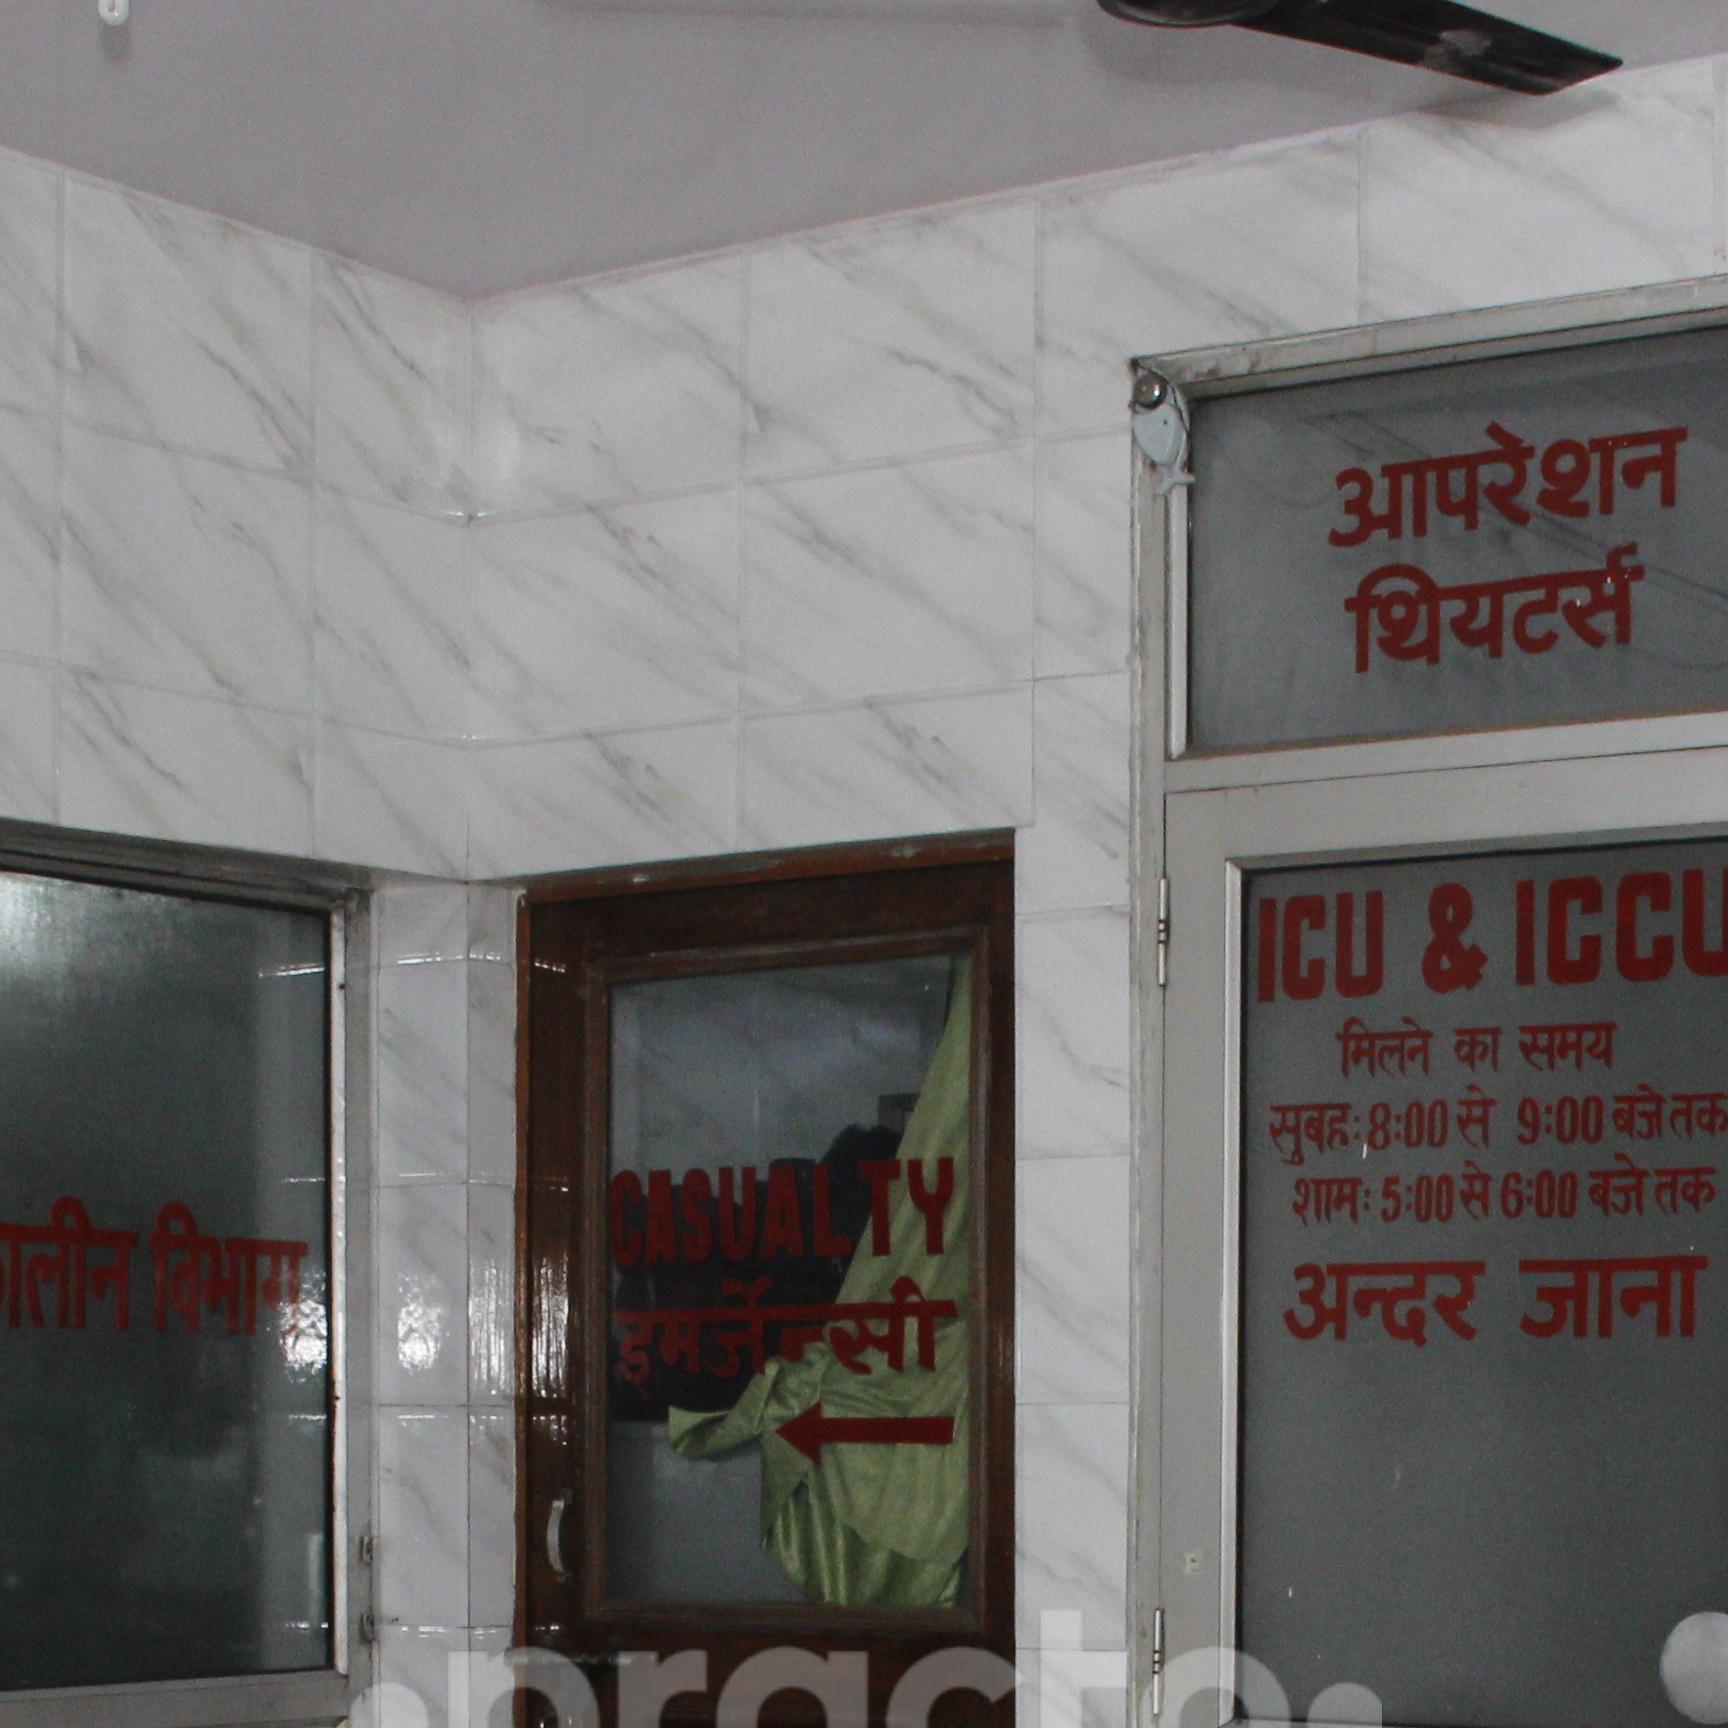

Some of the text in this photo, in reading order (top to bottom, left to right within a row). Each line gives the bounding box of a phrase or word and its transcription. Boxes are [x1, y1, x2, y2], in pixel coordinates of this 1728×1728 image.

[1327, 420, 1689, 548] आपरेशन
[1257, 890, 1384, 1002] ICU
[1421, 882, 1488, 996] &
[1336, 1017, 1617, 1078] मिलने का समय
[1368, 1099, 1449, 1150] 8:00
[1457, 1084, 1497, 1149] से
[1518, 1095, 1604, 1145] 9:00
[1613, 1083, 1665, 1140] बजे
[610, 1157, 954, 1268] CASUALTY
[1381, 1174, 1454, 1223] 5:00
[1460, 1159, 1493, 1221] से
[1501, 1170, 1579, 1219] 6:00
[1588, 1152, 1650, 1217] बजे
[1652, 1166, 1717, 1215] तक
[1283, 1255, 1709, 1348] अन्दर जाना
